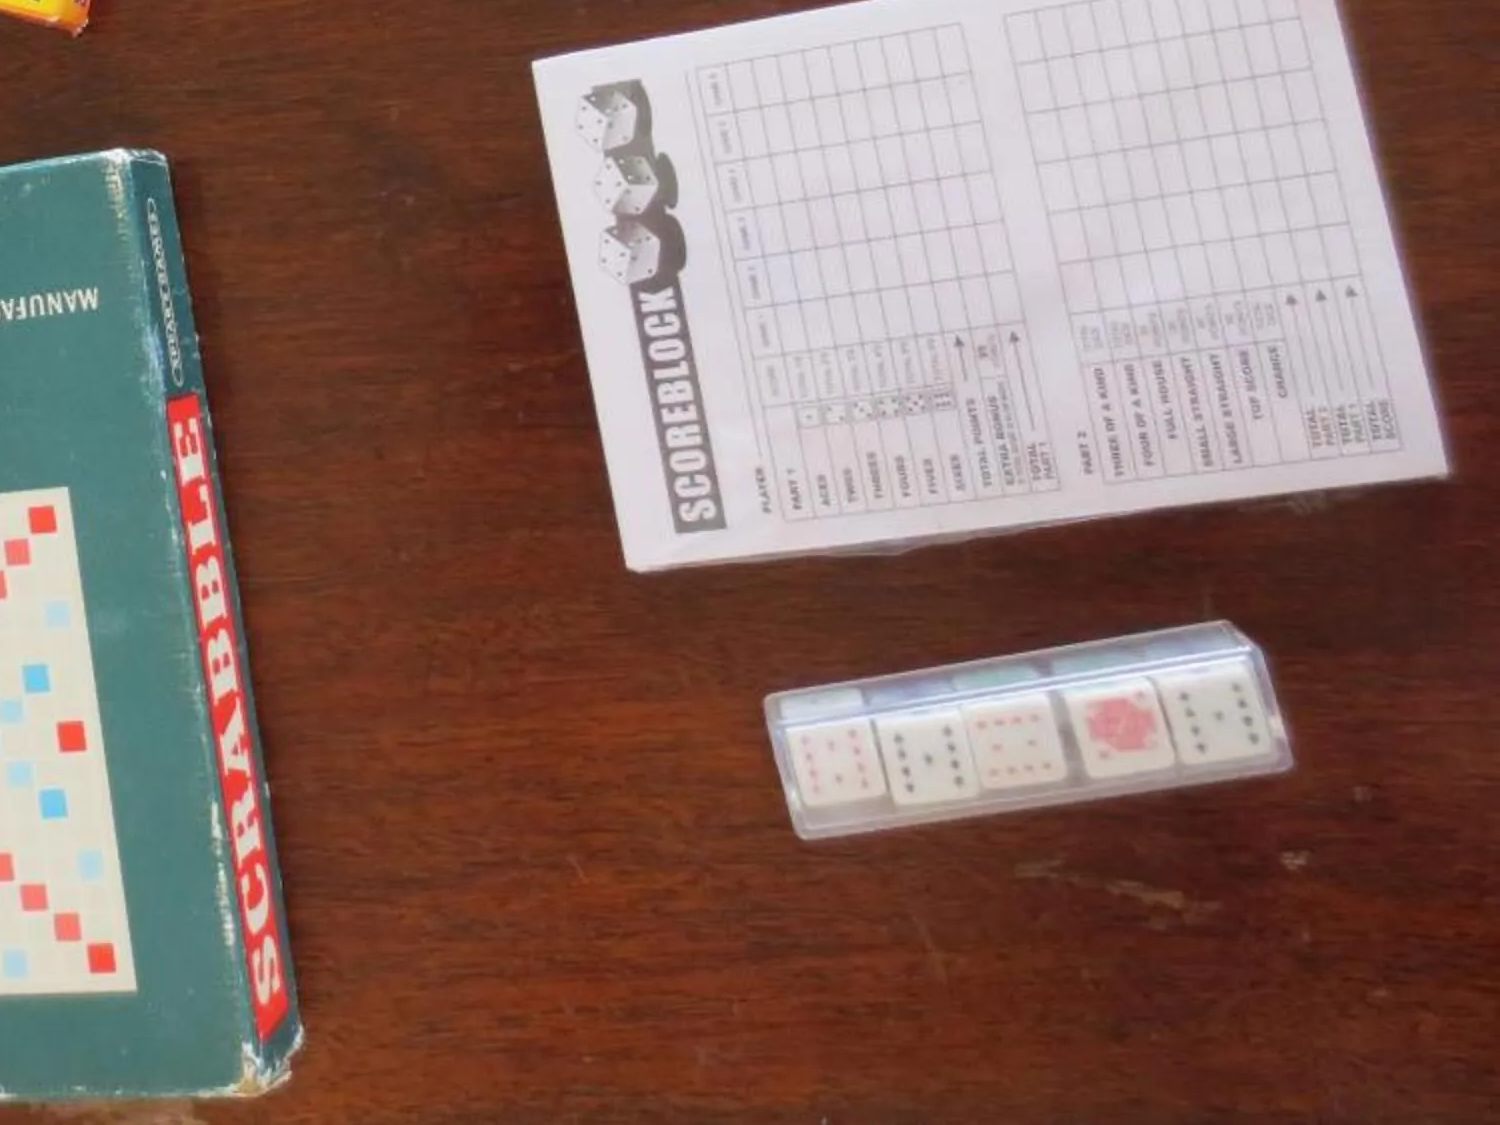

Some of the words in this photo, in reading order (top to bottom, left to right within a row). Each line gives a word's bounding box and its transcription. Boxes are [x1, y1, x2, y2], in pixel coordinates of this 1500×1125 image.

[636, 285, 718, 522] SCOREBLOCK
[1180, 356, 1203, 421] STRAIGHT
[1209, 352, 1232, 417] STRAIGHT
[174, 418, 282, 1007] SCRABBLE
